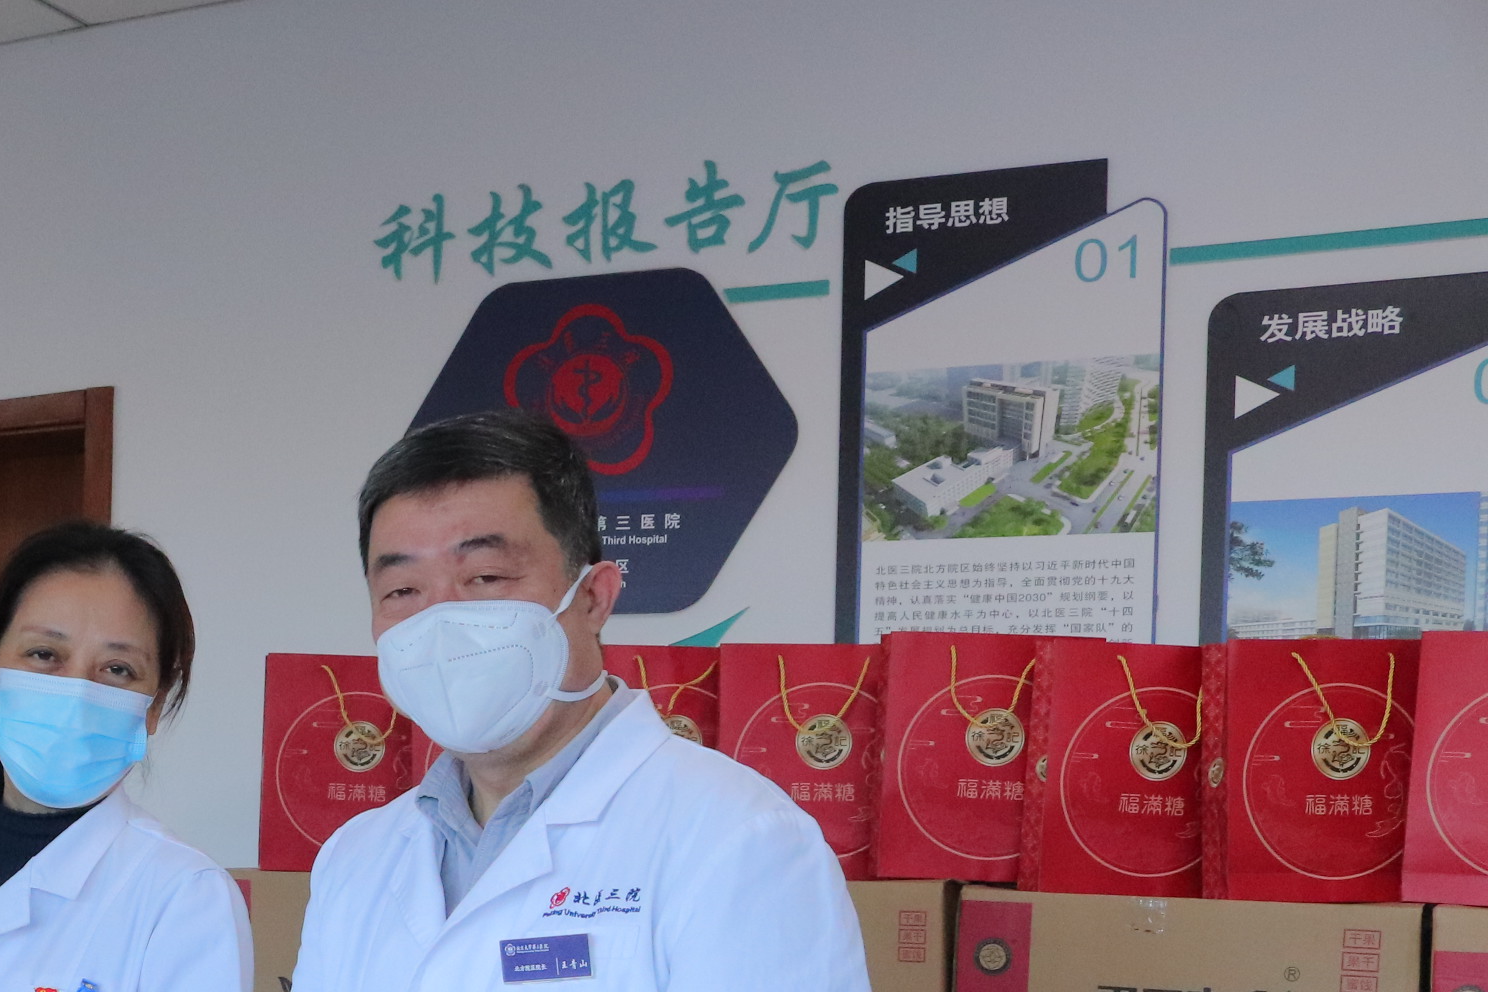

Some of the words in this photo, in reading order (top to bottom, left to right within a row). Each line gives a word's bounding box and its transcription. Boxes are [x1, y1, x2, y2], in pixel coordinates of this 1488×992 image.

[373, 160, 840, 285] 科技报告厅
[885, 197, 1010, 234] 指导思想
[1074, 234, 1139, 283] 01
[1259, 305, 1404, 343] 发展战略
[602, 535, 626, 545] Third
[628, 534, 668, 546] Hospital
